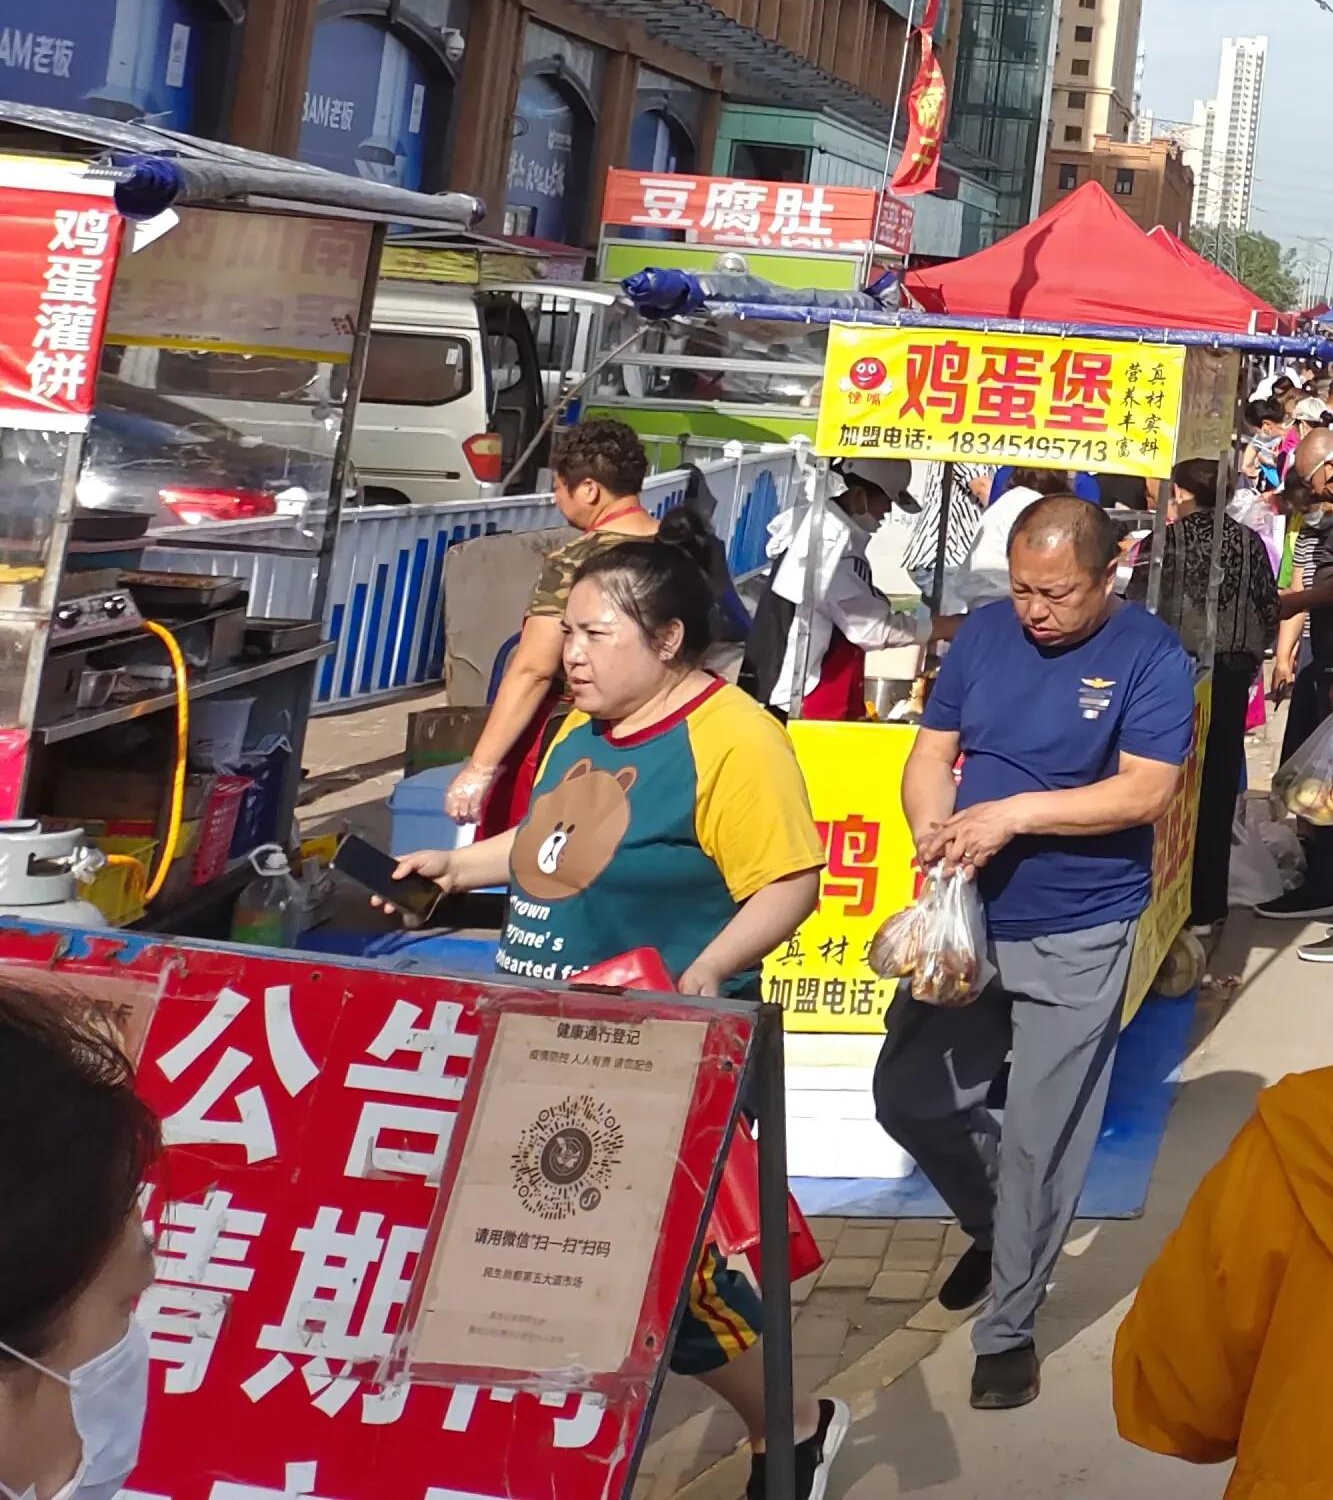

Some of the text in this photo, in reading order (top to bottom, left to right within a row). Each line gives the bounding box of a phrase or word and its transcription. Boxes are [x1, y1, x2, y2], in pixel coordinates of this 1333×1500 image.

[631, 178, 834, 236] 豆腐肚
[25, 209, 110, 401] 鸡蛋灌饼
[899, 340, 1113, 432] 鸡蛋堡
[1115, 363, 1144, 458] 营养丰富
[1138, 363, 1167, 460] 真材实料
[947, 432, 1109, 463] 18345195713
[556, 1021, 642, 1046] 健康通行登记
[156, 986, 480, 1188] 公告
